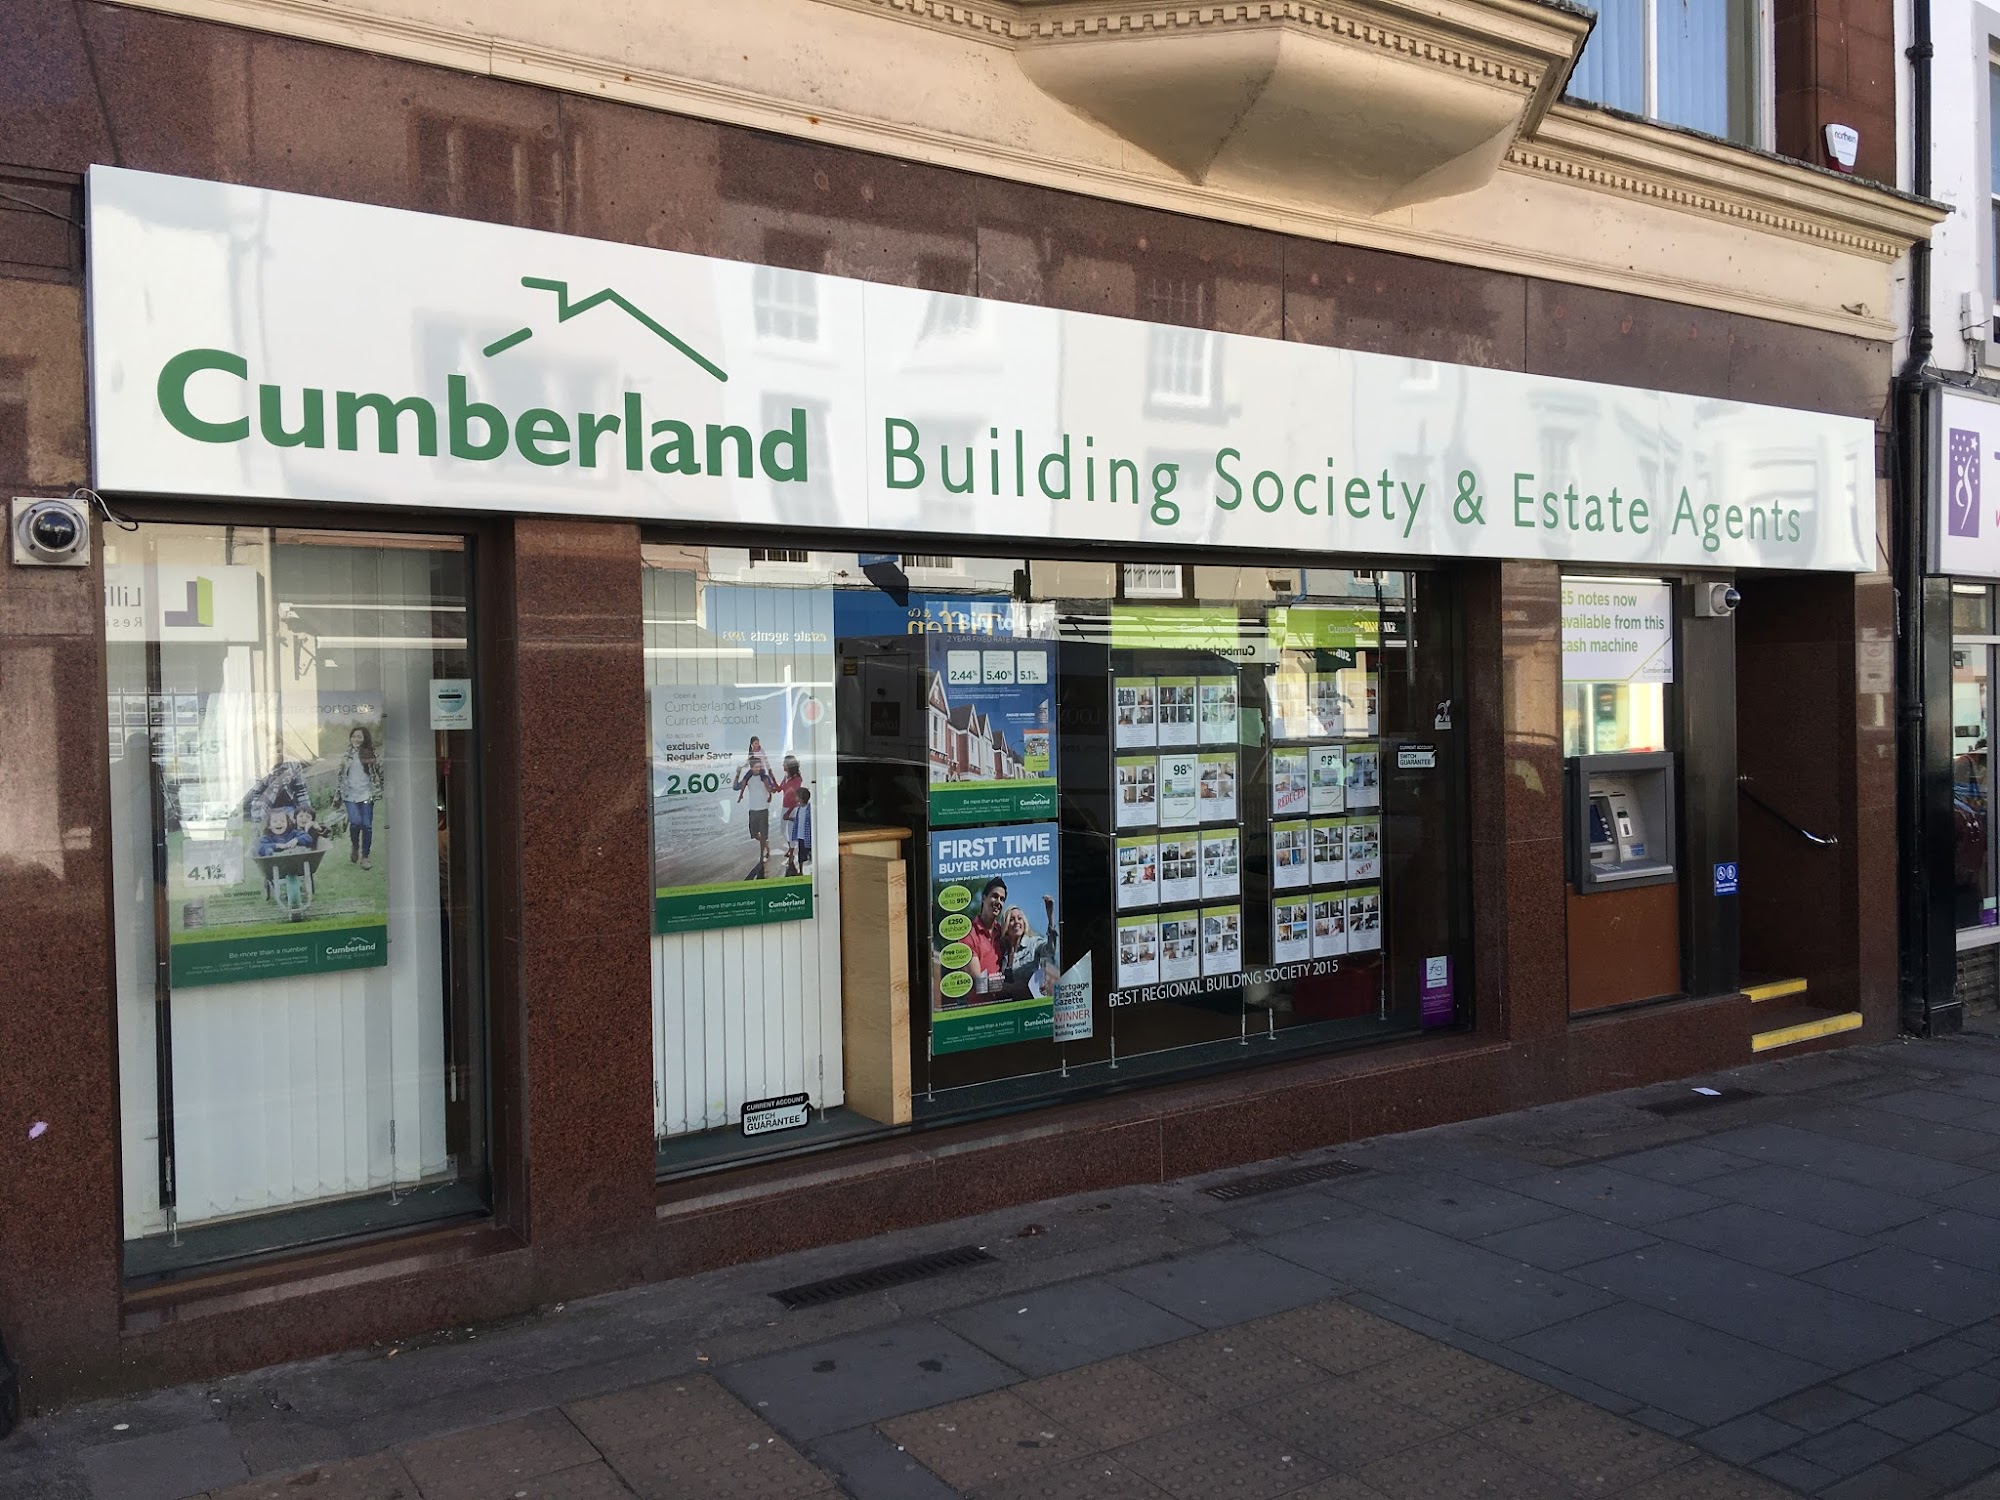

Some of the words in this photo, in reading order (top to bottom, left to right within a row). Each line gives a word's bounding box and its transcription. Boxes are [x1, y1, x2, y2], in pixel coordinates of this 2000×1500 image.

[156, 348, 808, 482] Cumberland
[885, 417, 1181, 525] Building
[1214, 446, 1428, 538] Society
[1453, 473, 1486, 525] &
[1513, 471, 1650, 533] Estate
[1670, 485, 1801, 552] Agents
[1577, 592, 1610, 606] notes
[1613, 595, 1637, 606] now
[997, 616, 1013, 631] to
[1020, 614, 1047, 631] Let
[1560, 614, 1611, 629] available
[1614, 614, 1642, 630] from
[1644, 615, 1665, 630] this
[952, 635, 972, 643] YEAR
[1561, 637, 1587, 653] cash
[1590, 637, 1638, 653] machine
[951, 670, 978, 680] 2.44%
[986, 670, 1013, 680] 5.40%
[1642, 666, 1672, 674] Cumberland
[665, 700, 735, 713] Cumberland
[739, 700, 762, 711] Plus
[665, 714, 708, 726] Current
[712, 712, 760, 725] Account
[666, 741, 710, 751] exclusive
[666, 752, 704, 763] Regular
[706, 751, 733, 760] Saver
[1320, 754, 1338, 766] 98%
[1400, 758, 1431, 766] GUARANTEE
[1173, 763, 1192, 775] 98%
[666, 772, 732, 796] 2.60%
[939, 837, 997, 859] FIRST
[1002, 833, 1050, 854] TIME
[939, 861, 978, 874] BUYER
[981, 855, 1050, 870] MORTGAGES
[187, 864, 222, 881] 4.1%
[769, 899, 805, 909] Cumberland
[229, 951, 238, 959] Be
[239, 950, 258, 958] more
[259, 948, 274, 957] than
[281, 945, 308, 954] number
[326, 942, 376, 955] Cumberland
[326, 952, 352, 961] Building
[1054, 982, 1089, 991] Mortgage
[1108, 988, 1139, 1008] BEST
[1141, 980, 1203, 1002] REGIONAL
[1206, 970, 1262, 992] BUILDING
[1264, 963, 1311, 983] SOCIETY
[1313, 959, 1339, 976] 2015
[1054, 990, 1082, 999] Finance
[1054, 997, 1084, 1006] Gazette
[1054, 1009, 1090, 1022] WINNER
[1055, 1029, 1073, 1037] Building
[747, 1100, 775, 1111] CURRENT
[776, 1095, 804, 1107] ACCOUNT
[747, 1112, 776, 1123] SWITCH
[747, 1114, 801, 1131] GUARANTEE
